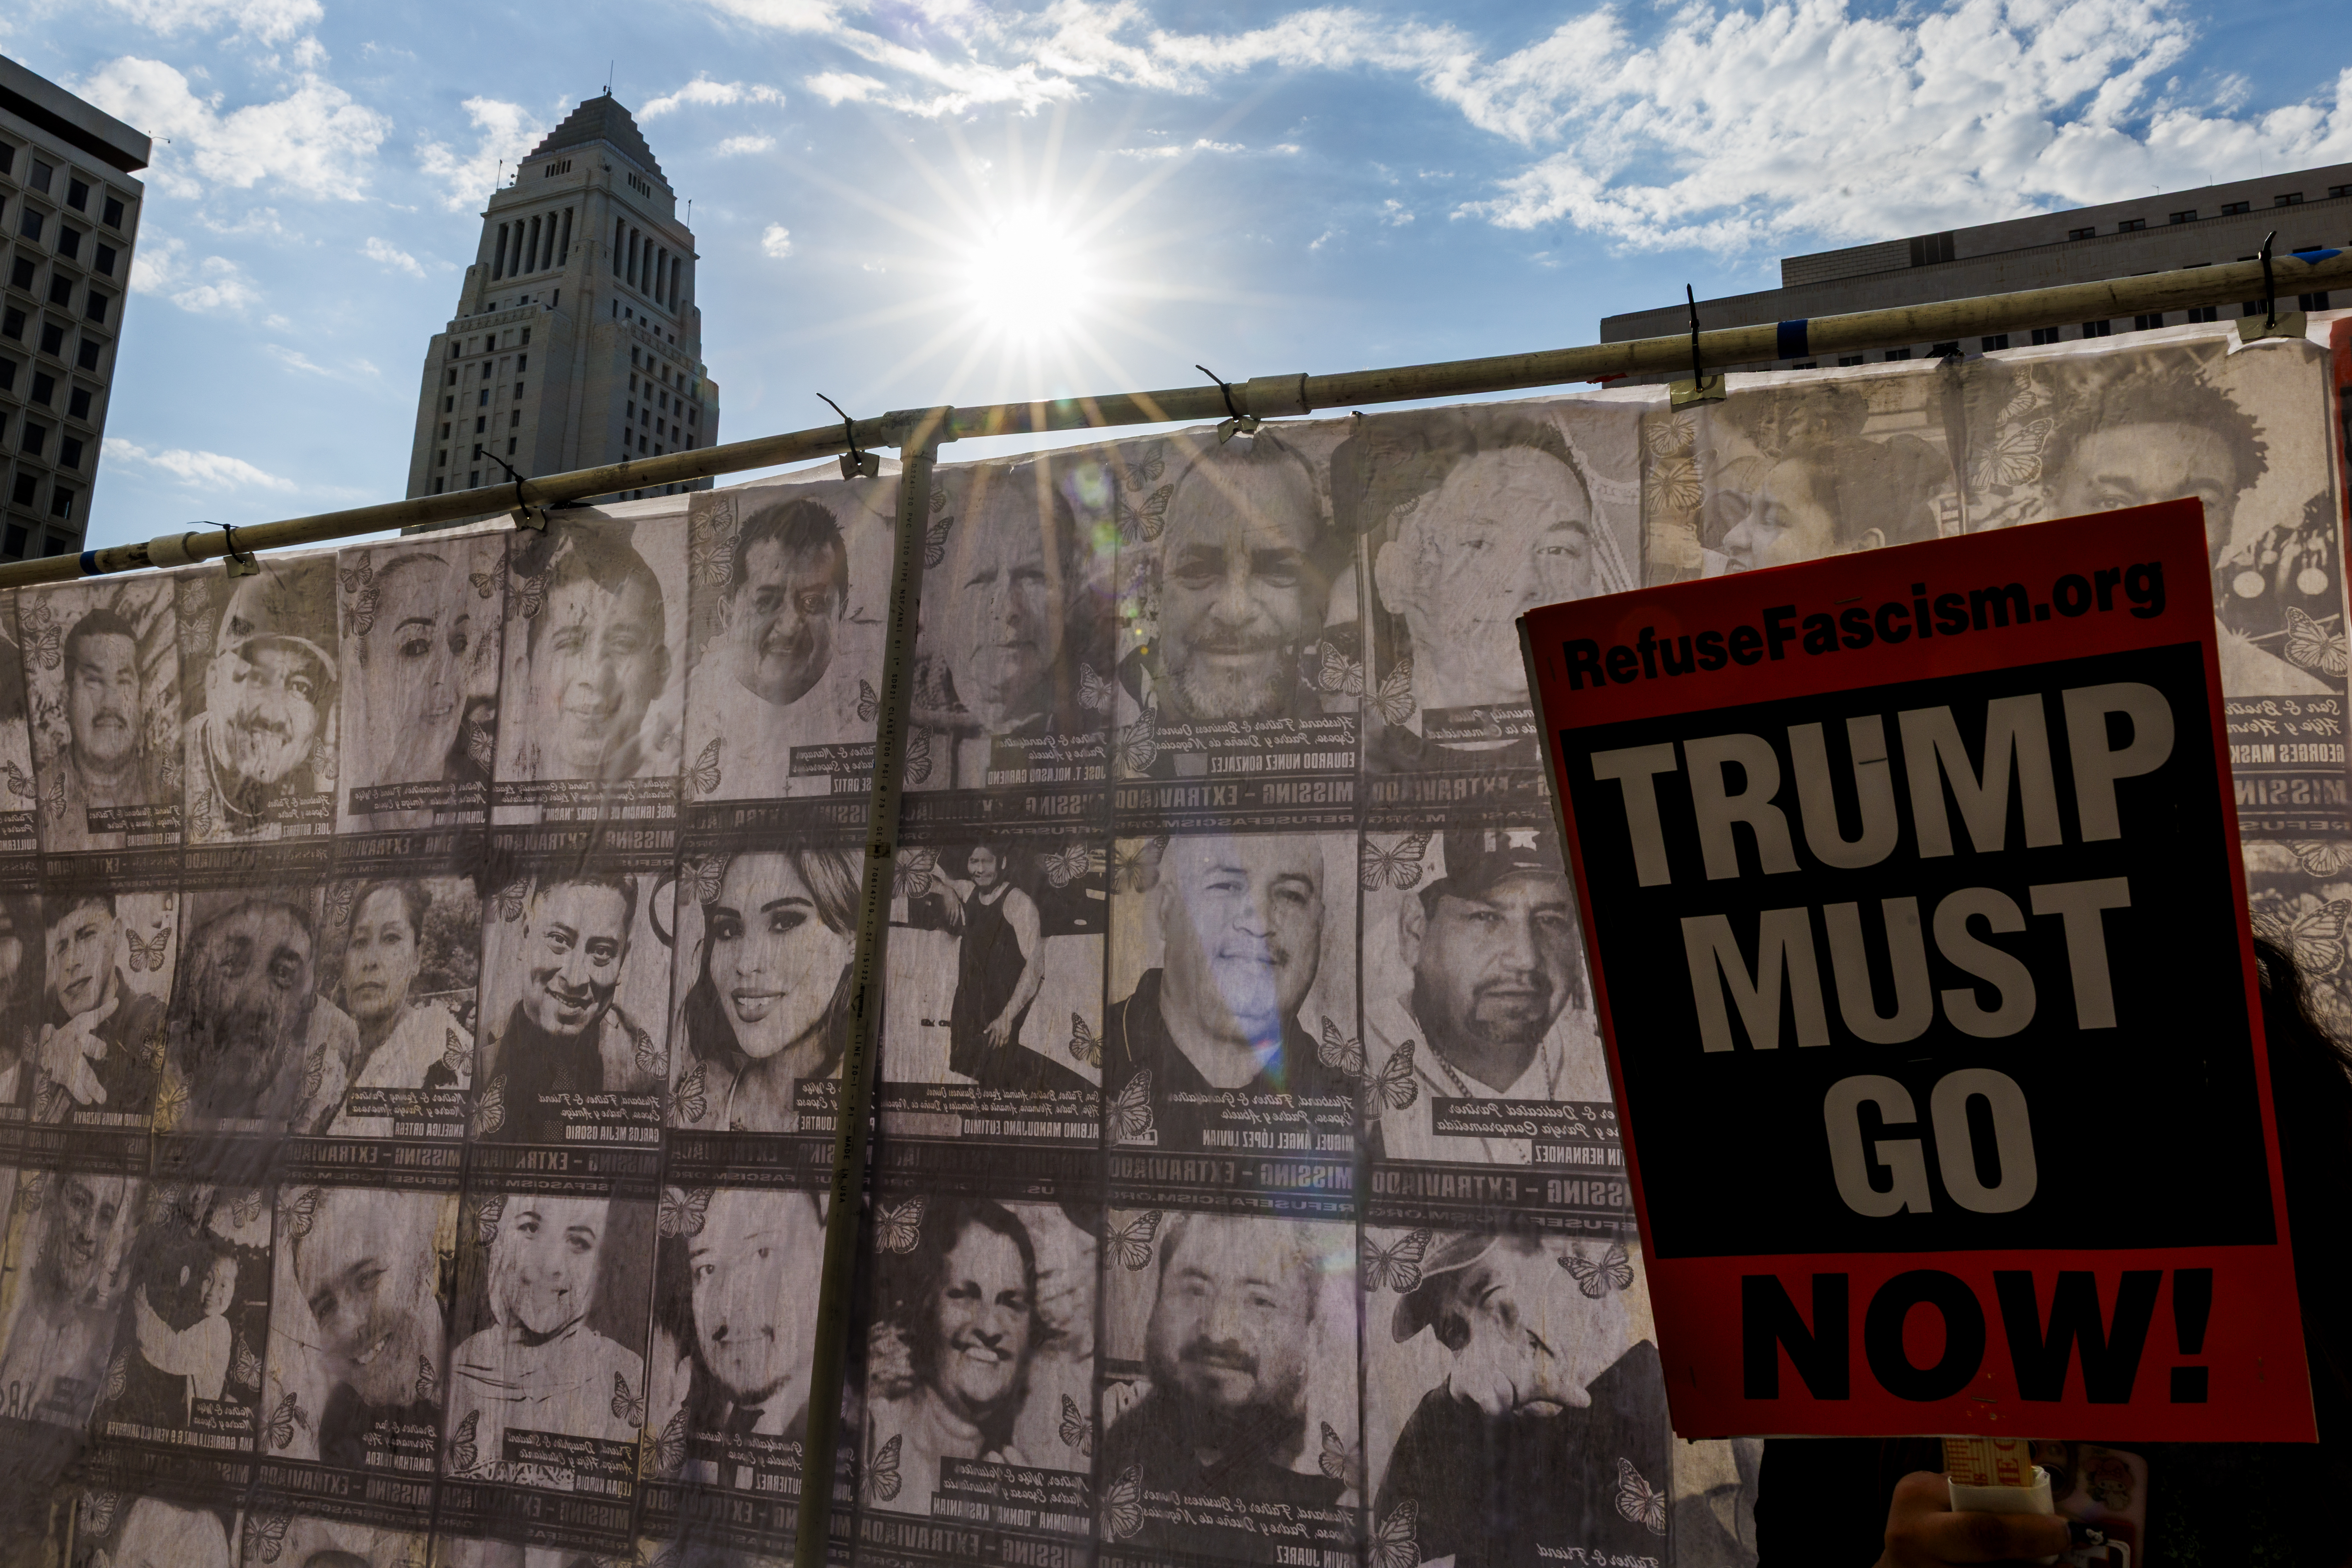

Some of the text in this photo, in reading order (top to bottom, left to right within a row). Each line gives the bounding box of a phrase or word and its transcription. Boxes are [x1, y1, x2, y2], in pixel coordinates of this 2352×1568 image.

[907, 463, 917, 506] D2241-20
[896, 589, 906, 632] NSF/ANSI
[1566, 559, 2167, 691] RefuseFascism.org
[894, 640, 900, 649] 61
[889, 673, 898, 699] SDR21
[886, 707, 894, 734] CLASS
[1589, 681, 2176, 888] TRUMP
[879, 798, 885, 808] 73
[1679, 876, 2133, 1054] MUST
[848, 1107, 854, 1117] P1
[843, 1136, 852, 1160] MADE
[1822, 1067, 2038, 1218] GO
[841, 1169, 848, 1178] IN
[1741, 1268, 2214, 1404] NOW!
